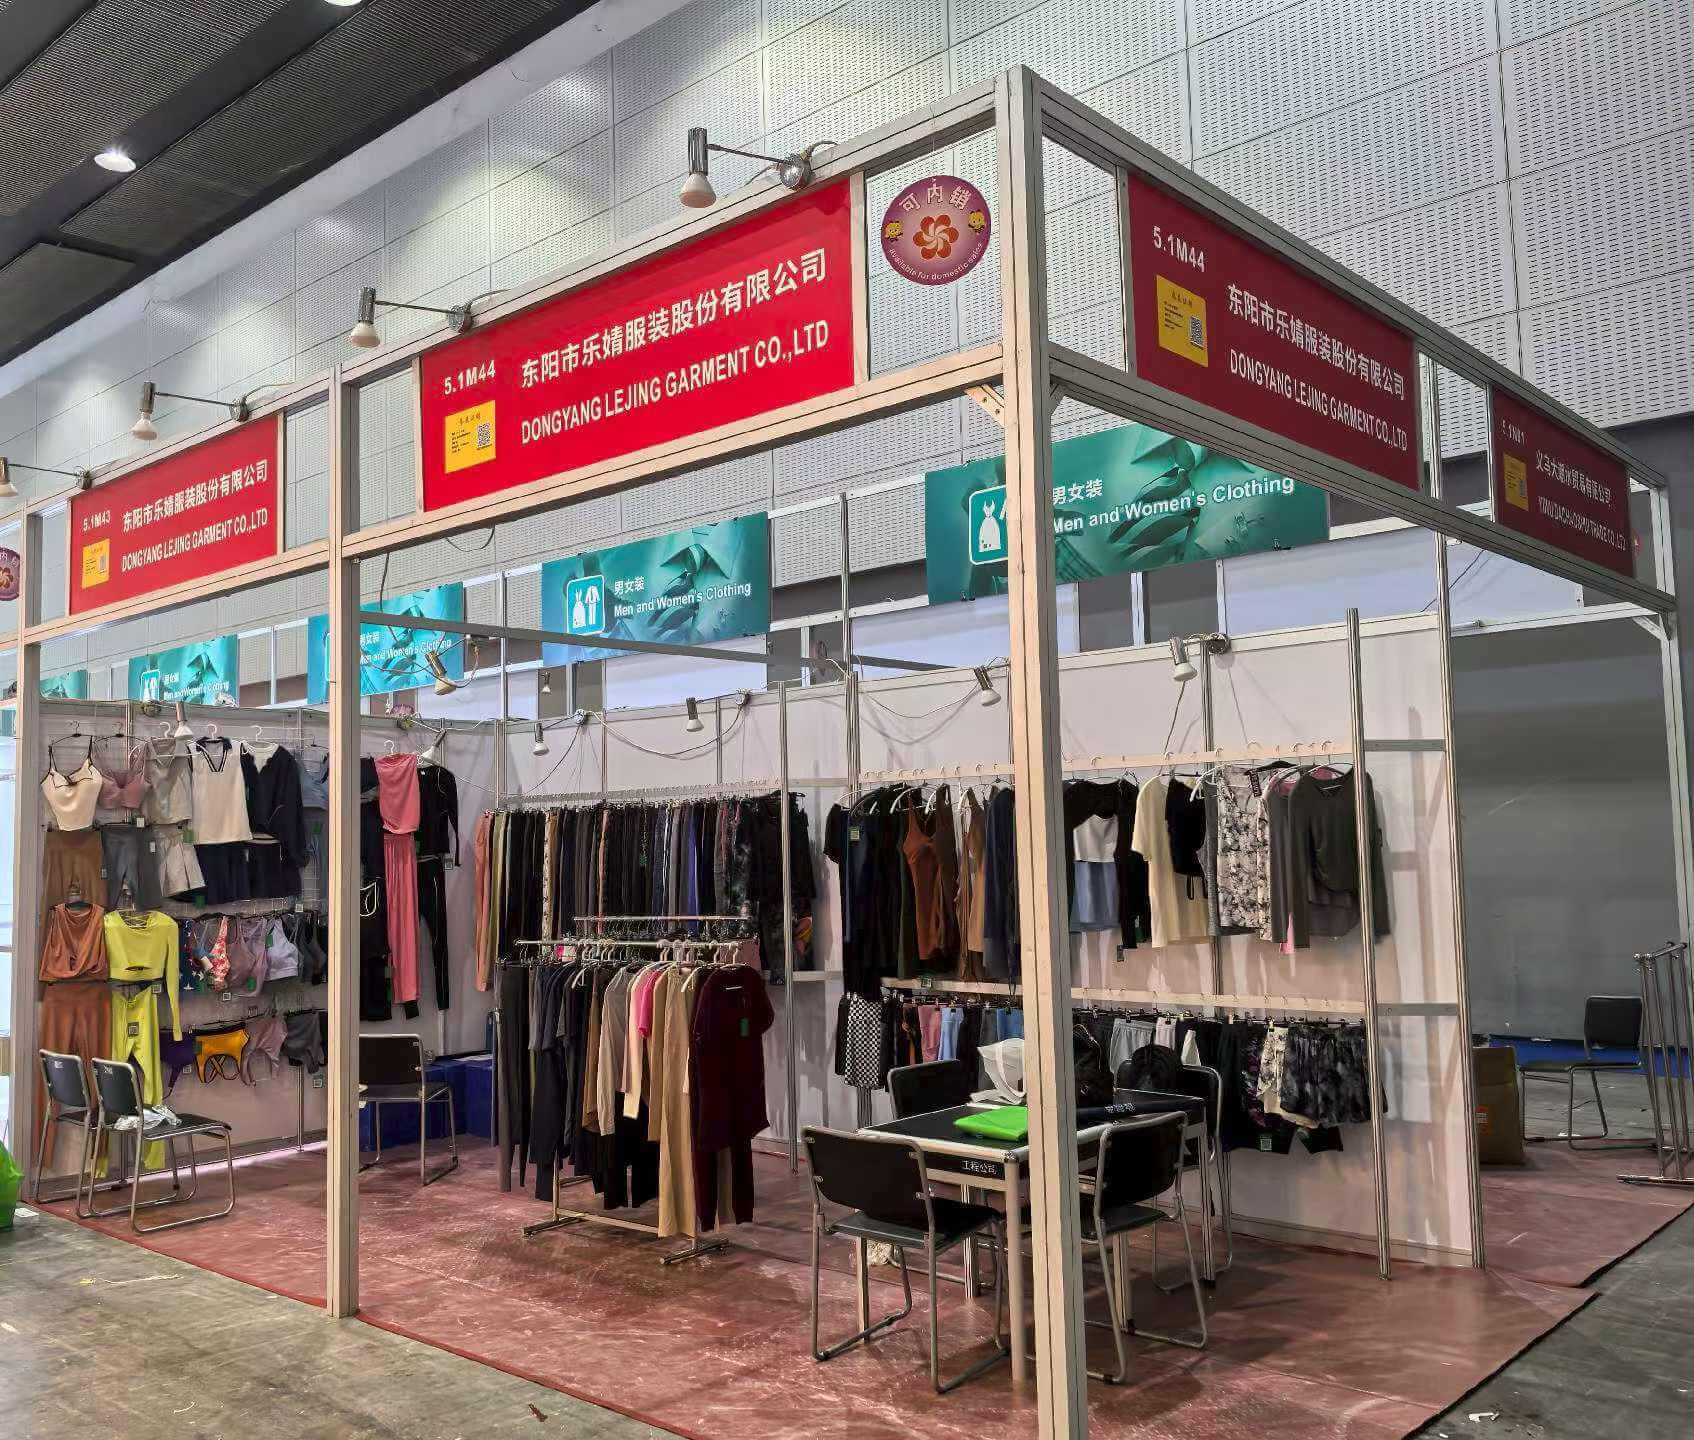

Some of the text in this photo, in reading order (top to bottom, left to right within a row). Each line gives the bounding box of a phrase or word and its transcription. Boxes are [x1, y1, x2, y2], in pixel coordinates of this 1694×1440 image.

[898, 183, 972, 211] 可内销
[1153, 225, 1205, 272] 5.1M44
[521, 247, 825, 388] 东阳市乐婧服装股份有限公司
[444, 359, 496, 395] 5.1M44
[521, 396, 601, 444] DONGYANG
[605, 376, 661, 417] LEJING
[665, 346, 750, 397] GARMENT
[754, 319, 829, 368] CO.,LTD
[1230, 348, 1292, 400] DONGYANG
[1293, 378, 1328, 416] LEJING
[1330, 396, 1375, 436] GARMENT
[1052, 478, 1103, 505] 男女装
[1053, 475, 1295, 534] Men and Women's Clothing
[121, 547, 163, 573] DONGYANG
[163, 534, 191, 559] LEJING
[192, 520, 233, 547] GARMENT
[614, 575, 645, 596] 男女装
[614, 581, 752, 618] Men and Women's Clothing
